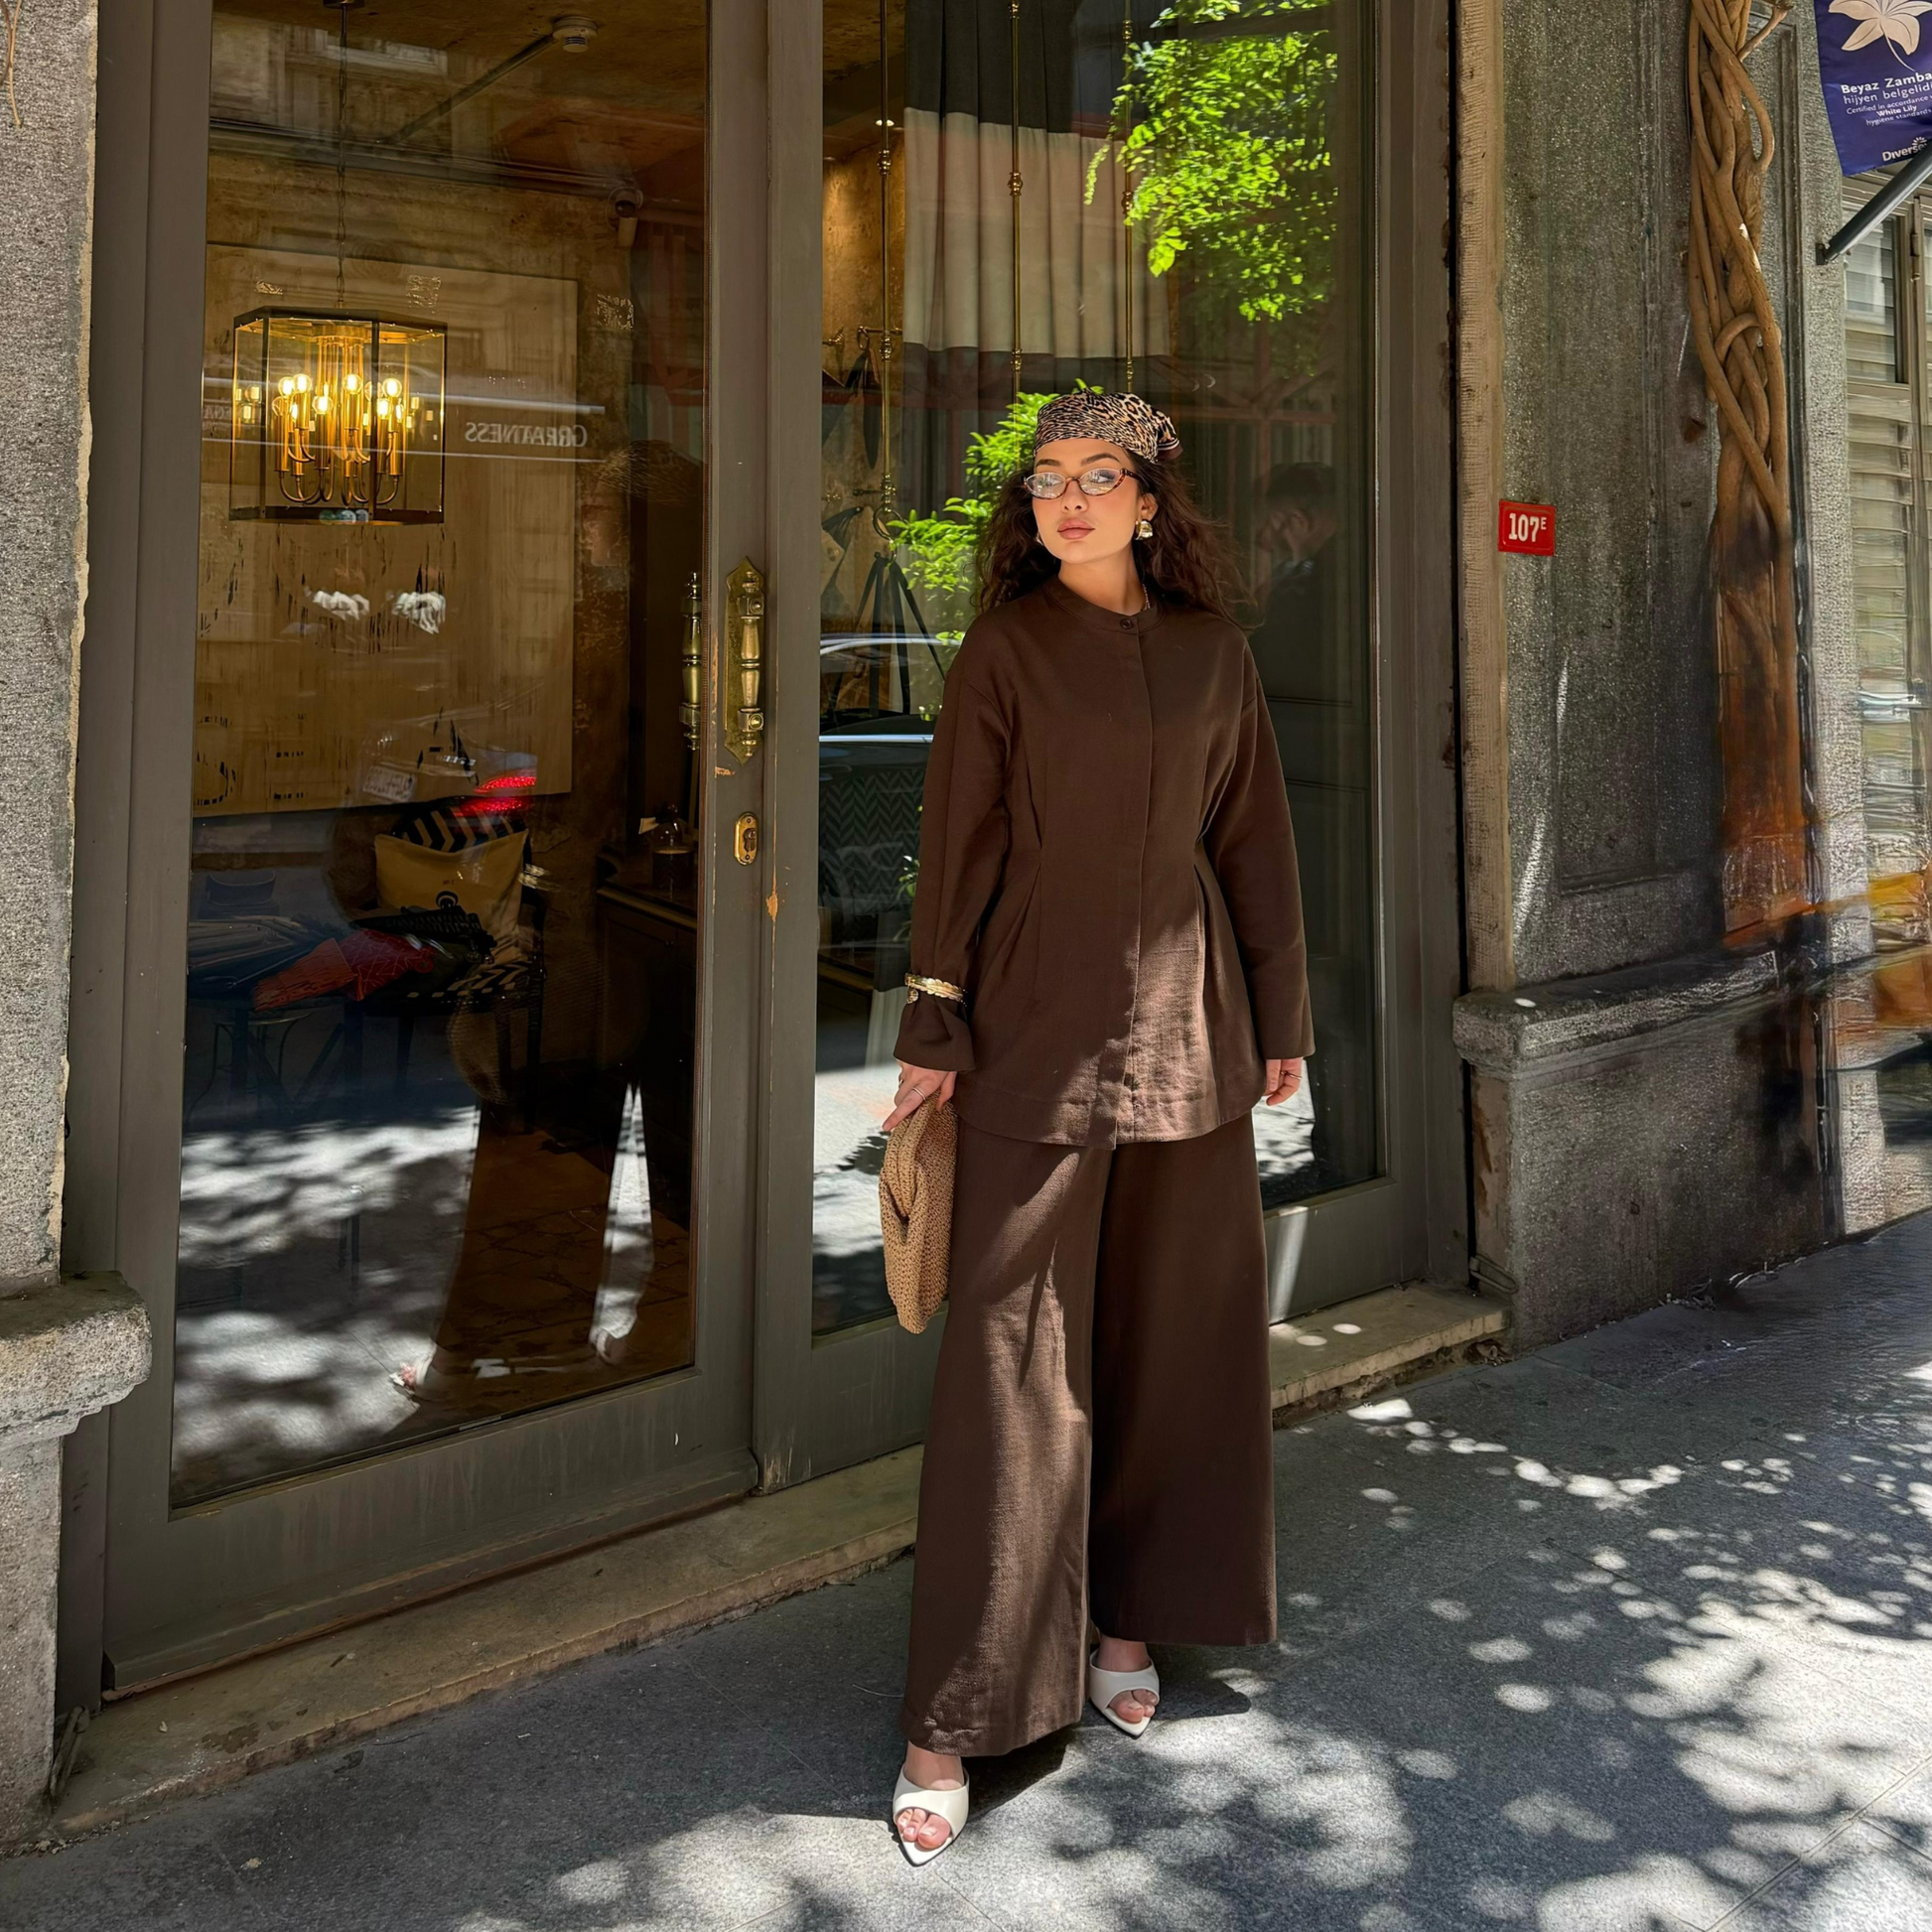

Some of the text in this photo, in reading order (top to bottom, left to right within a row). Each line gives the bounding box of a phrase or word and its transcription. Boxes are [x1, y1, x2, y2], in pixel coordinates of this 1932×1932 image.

[1841, 72, 1932, 94] Beyaz Zamba
[1843, 94, 1878, 105] hijyen
[1847, 104, 1876, 114] Certified
[1886, 95, 1929, 108] accordance
[1865, 108, 1932, 126] hygiene standards
[1876, 108, 1902, 117] White
